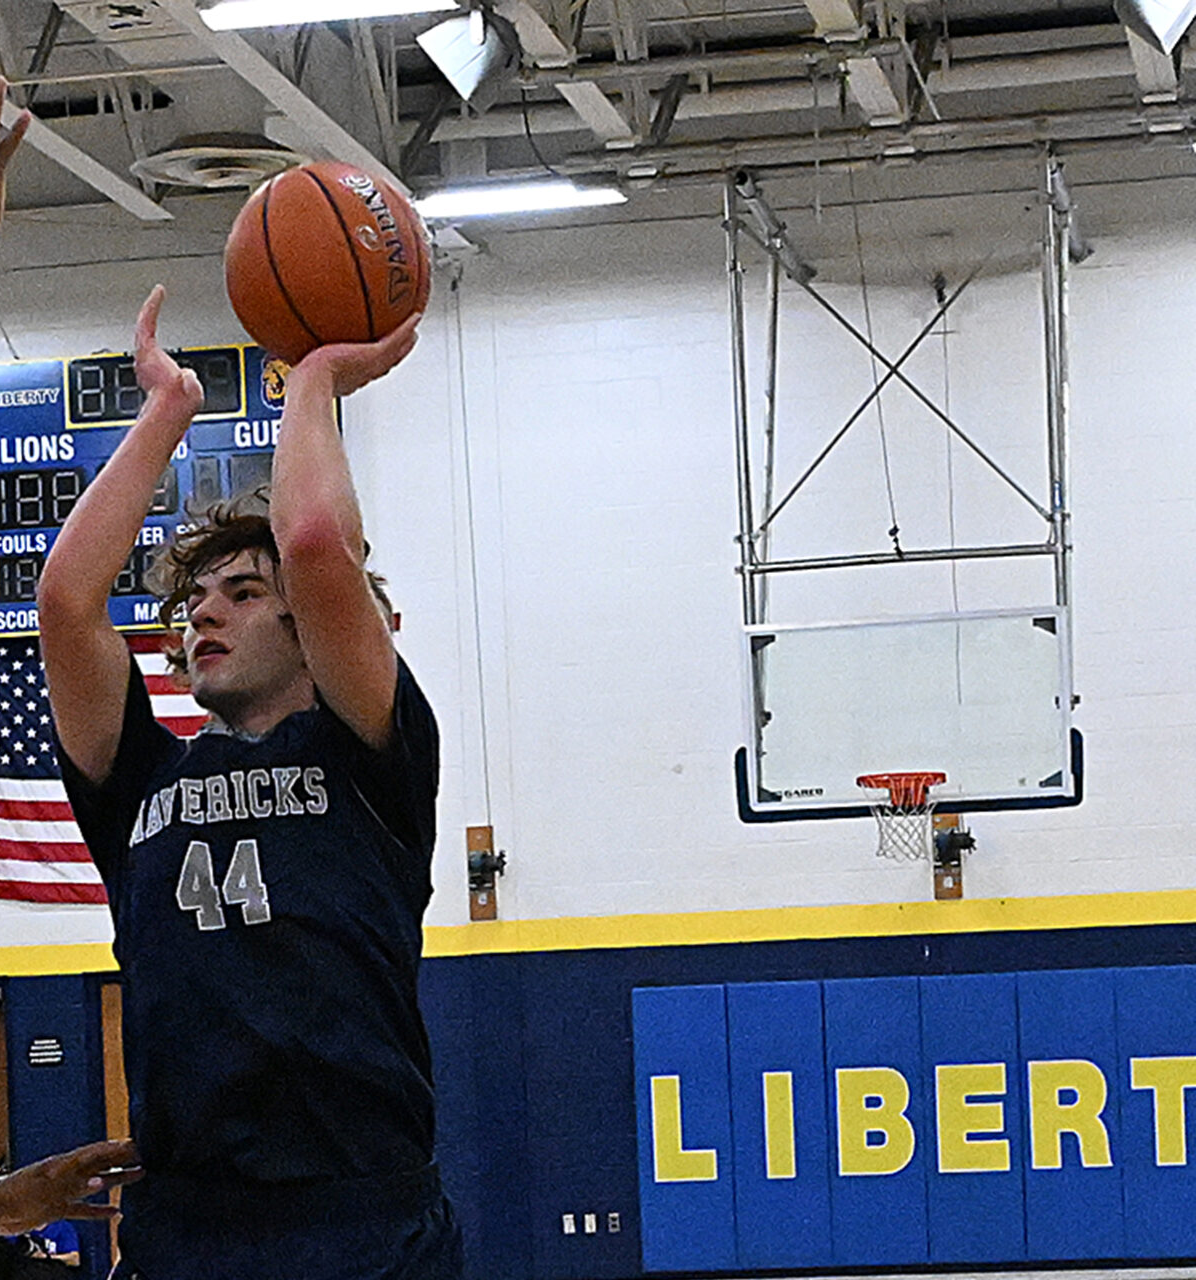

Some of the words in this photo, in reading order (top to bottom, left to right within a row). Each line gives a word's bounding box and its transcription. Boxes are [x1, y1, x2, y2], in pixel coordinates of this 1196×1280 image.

[0, 433, 75, 465] LIONS
[234, 420, 282, 448] GUE
[176, 838, 272, 931] 44
[650, 1056, 1196, 1183] LIBERT
